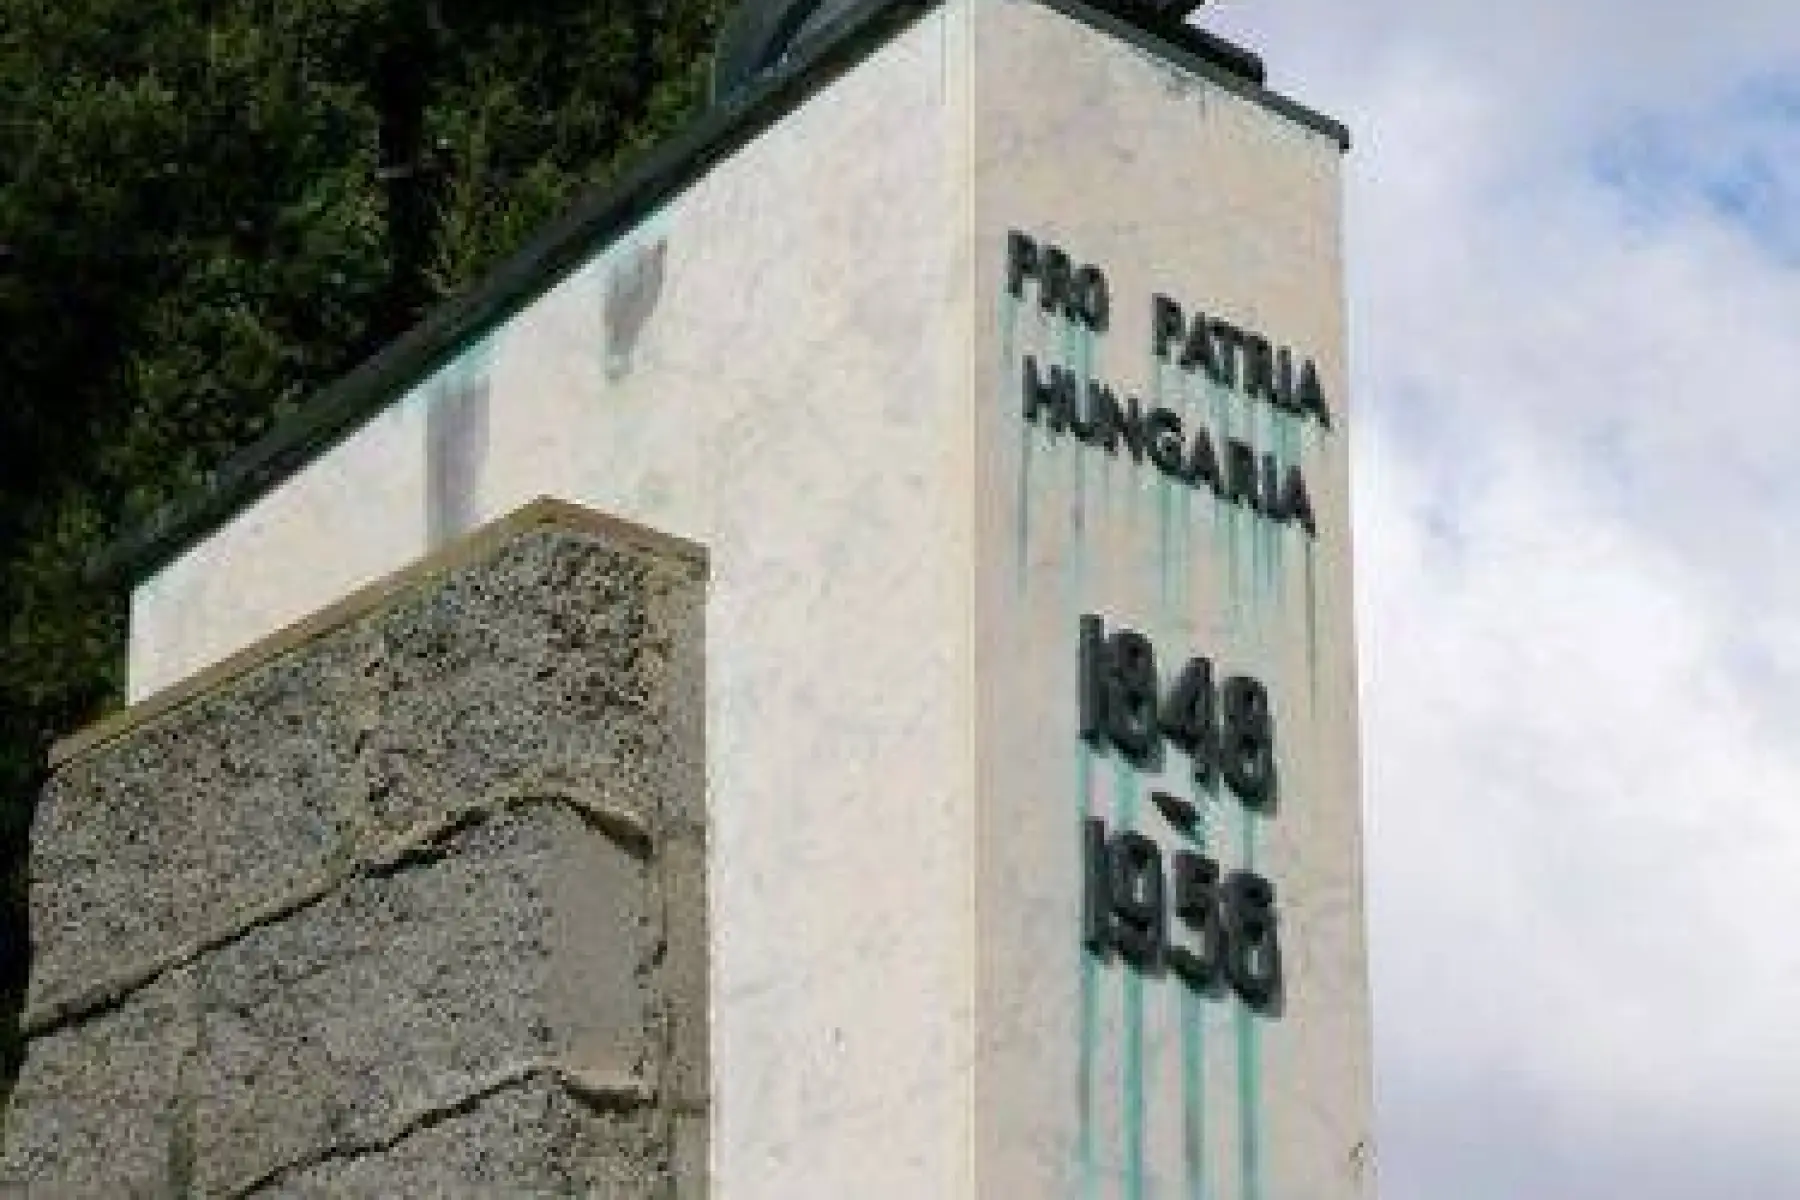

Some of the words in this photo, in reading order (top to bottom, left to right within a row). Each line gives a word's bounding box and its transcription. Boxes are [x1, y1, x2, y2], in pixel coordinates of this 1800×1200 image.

[1007, 228, 1110, 332] PRO
[1151, 293, 1330, 430] PATRIA
[1022, 354, 1316, 539] HUNGARIA
[1078, 613, 1278, 819] 1848
